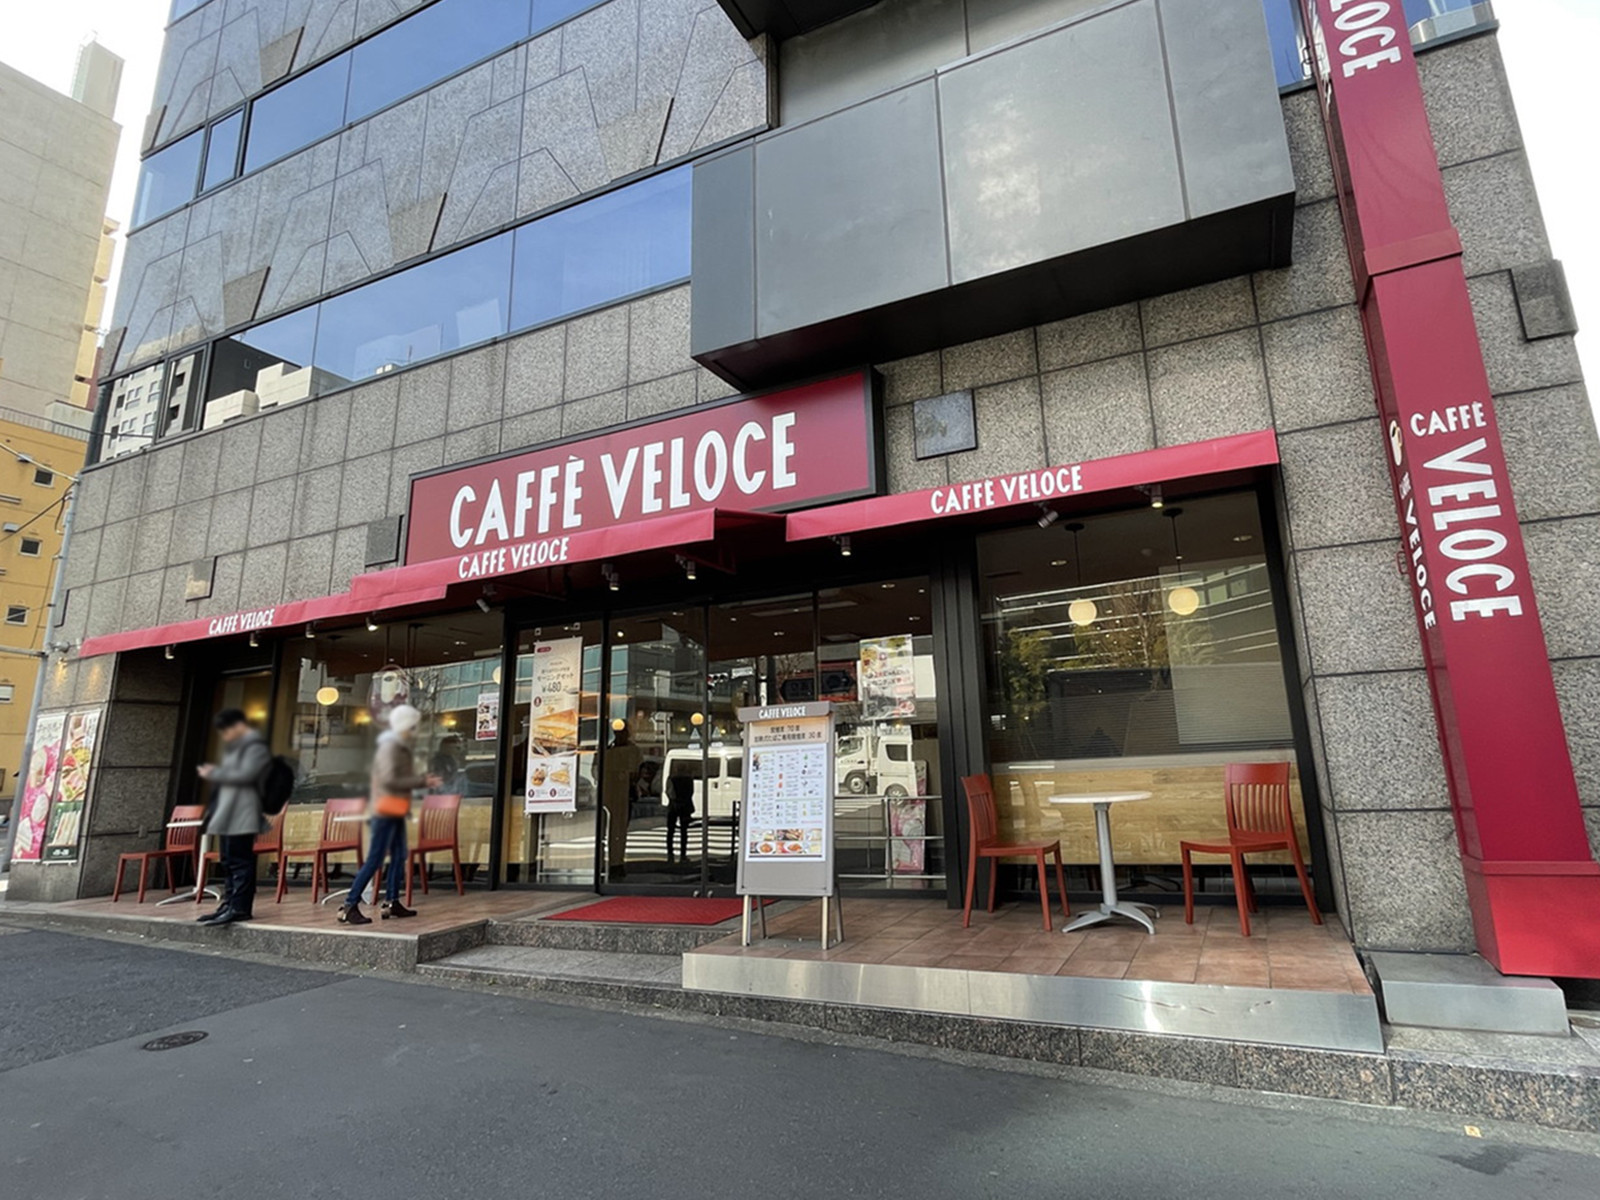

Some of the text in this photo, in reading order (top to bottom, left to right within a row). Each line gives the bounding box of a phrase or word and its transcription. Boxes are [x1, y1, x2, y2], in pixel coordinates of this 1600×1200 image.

[449, 411, 797, 550] CAFFÈ VELOCE
[929, 465, 1085, 515] CAFFÈ VELOCE
[511, 535, 570, 569] VELOCE
[1422, 437, 1524, 623] VELOCE
[1405, 498, 1438, 630] VELOCE
[240, 608, 275, 631] VELOCE
[780, 706, 806, 718] VELOCE
